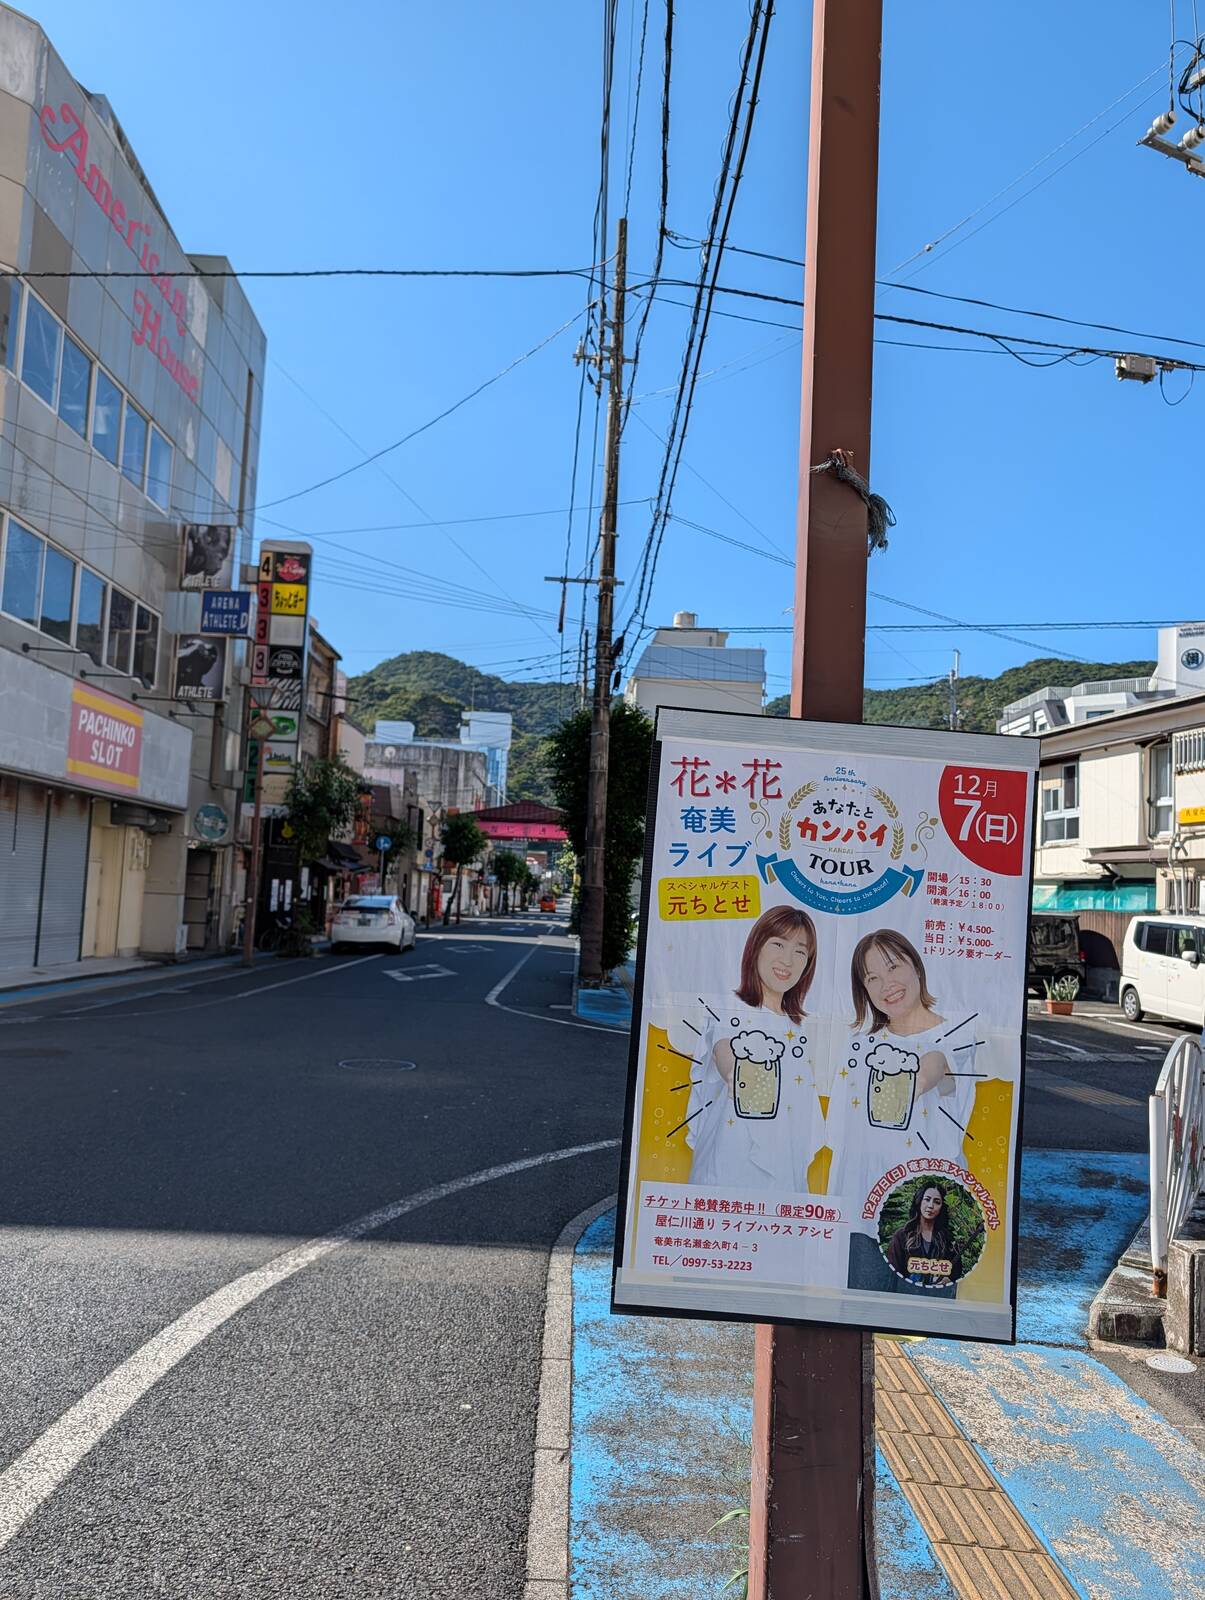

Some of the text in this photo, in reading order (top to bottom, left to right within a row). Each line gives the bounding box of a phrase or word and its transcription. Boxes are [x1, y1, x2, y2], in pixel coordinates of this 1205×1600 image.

[40, 103, 187, 336] American
[132, 288, 199, 403] House
[262, 556, 271, 576] 4
[211, 596, 240, 610] ARENA
[260, 588, 269, 608] 3
[258, 621, 267, 639] 3
[255, 652, 265, 670] 3
[178, 685, 213, 698] ATHLETE
[78, 708, 136, 748] PACHINKO
[90, 741, 123, 767] SLOT
[823, 775, 867, 788] Anniversary
[952, 774, 997, 798] 12月
[812, 798, 874, 819] あなたと
[680, 806, 737, 834] 奄美
[796, 816, 888, 847] カンパイ
[669, 840, 752, 868] ライブ
[809, 853, 874, 877] TOUR
[667, 880, 750, 891] スペシャルゲスト
[790, 870, 806, 889] Cheers
[862, 891, 873, 899] the
[668, 894, 751, 915] 元ちとせ
[655, 1214, 834, 1240] 屋仁川通り ライブハウス アシビ
[910, 1259, 950, 1273] 元ちとせ
